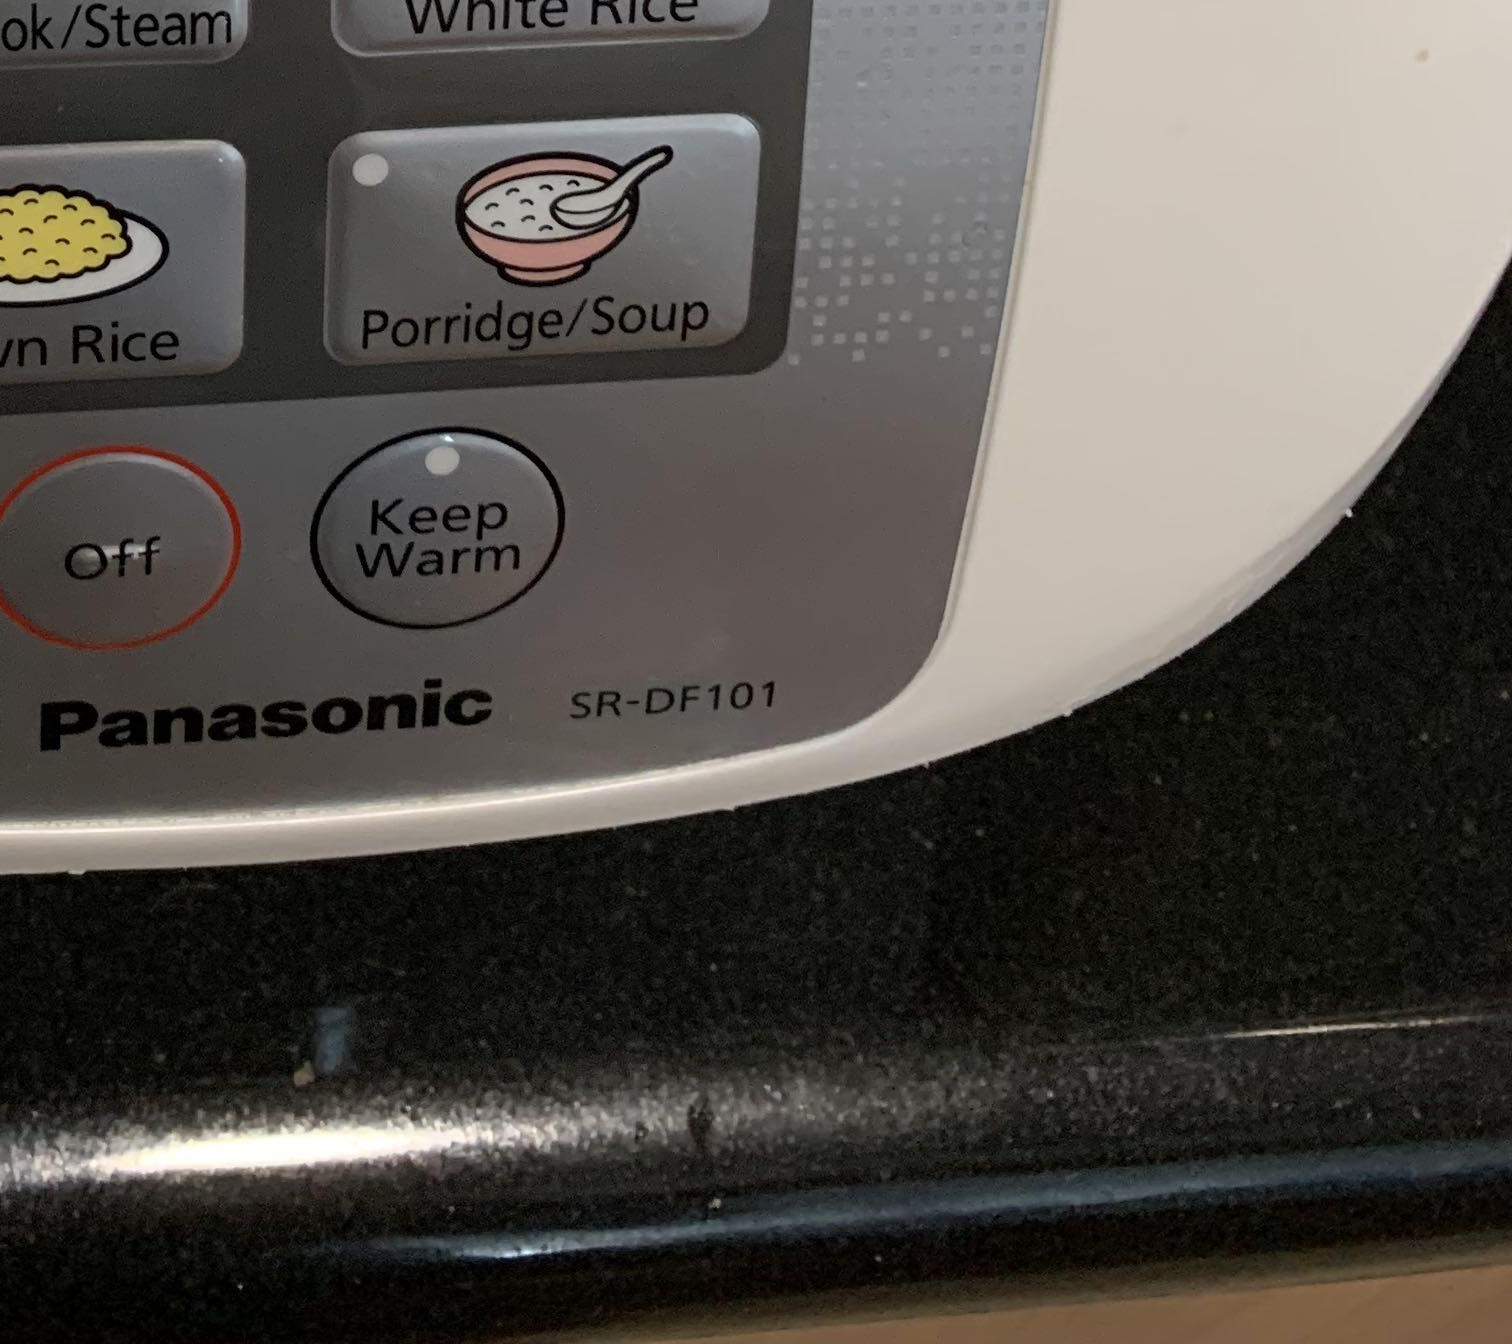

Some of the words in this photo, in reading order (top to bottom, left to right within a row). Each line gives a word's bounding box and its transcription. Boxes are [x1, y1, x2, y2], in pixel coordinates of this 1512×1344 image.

[71, 321, 180, 366] Rice
[361, 295, 710, 350] Porridge/Soup
[369, 498, 509, 541] Keep
[63, 536, 161, 580] Off
[354, 539, 522, 579] Warm
[37, 679, 493, 751] Panasonic
[568, 680, 777, 721] SR-DF101
